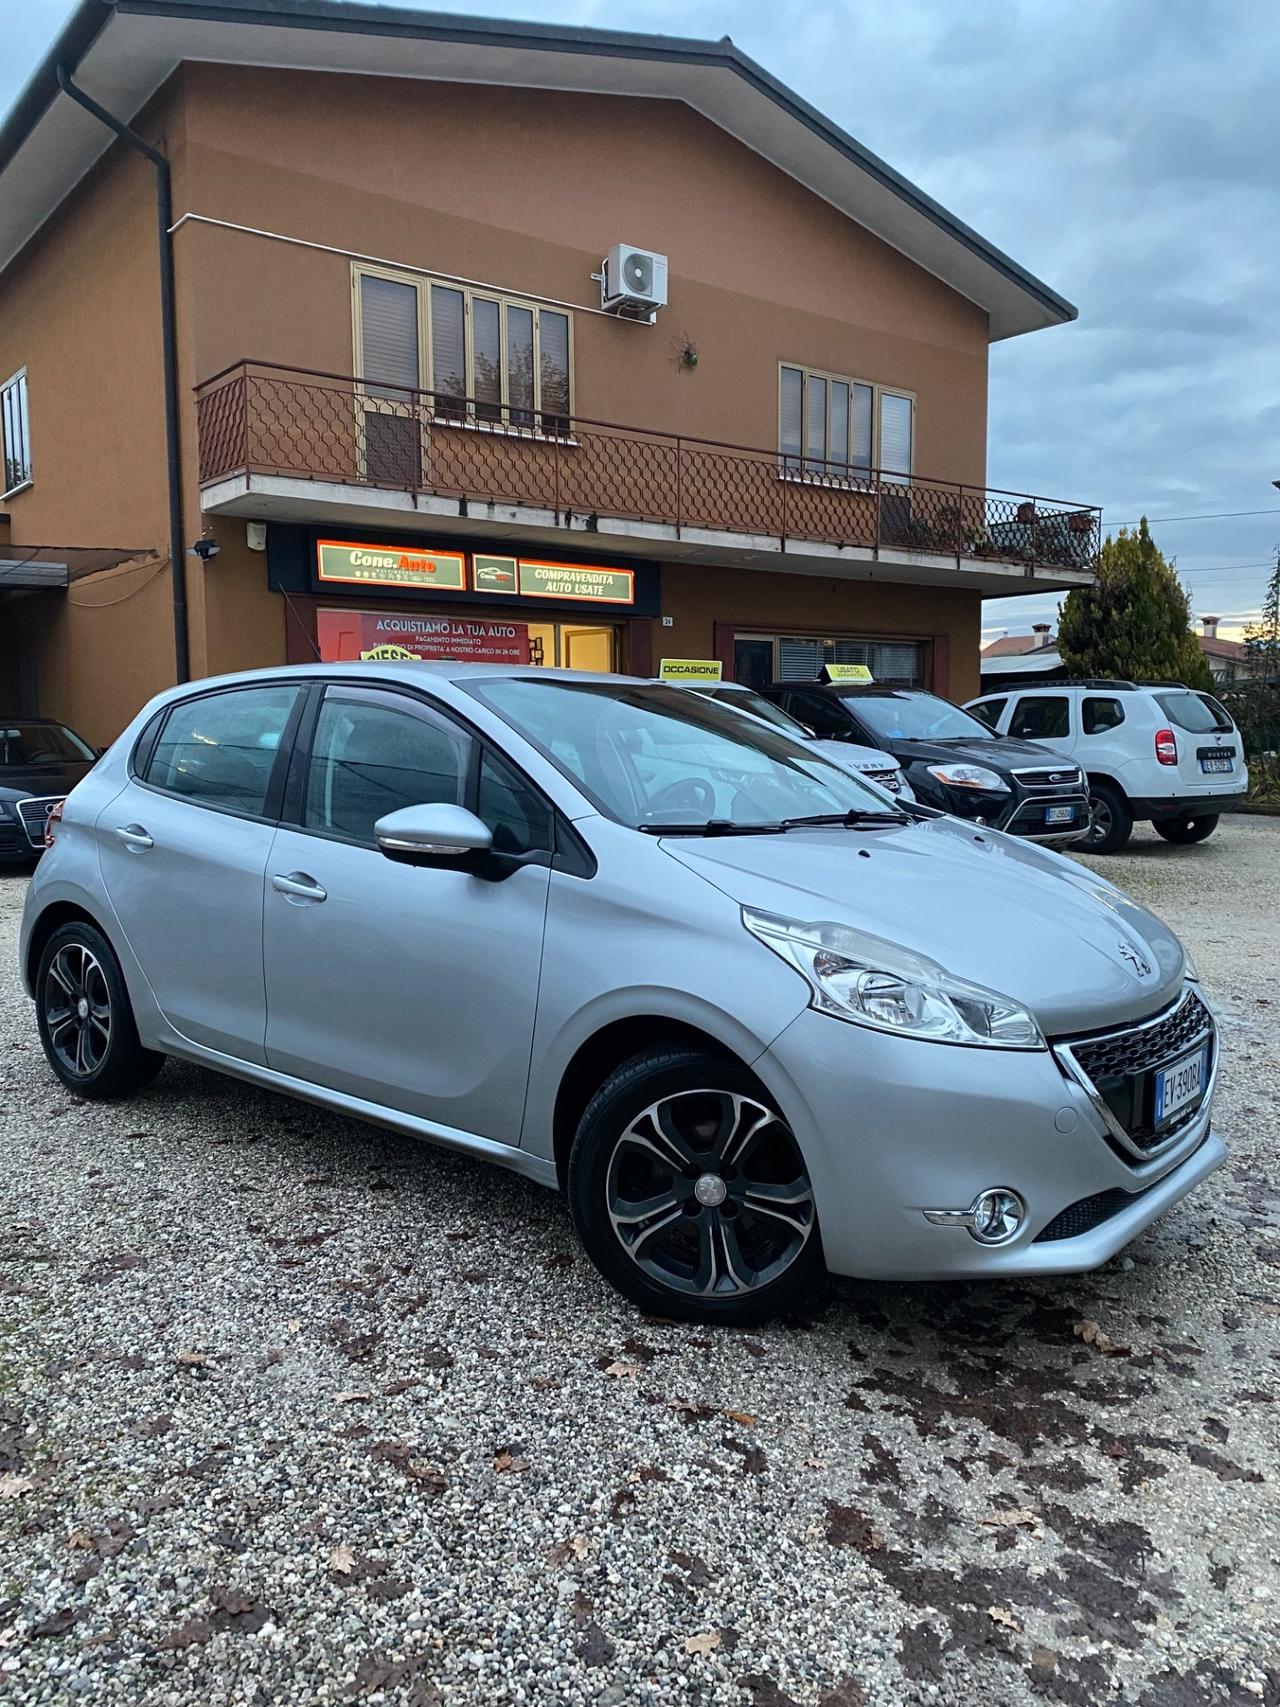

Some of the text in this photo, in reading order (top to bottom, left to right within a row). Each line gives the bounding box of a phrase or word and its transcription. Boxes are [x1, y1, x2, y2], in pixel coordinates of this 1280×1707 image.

[349, 550, 436, 573] Cone.Auto
[534, 568, 614, 585] COMPRAVENDITA
[545, 582, 604, 595] AUTO USATE
[376, 619, 516, 638] ACQUISTIAMO LA TUA AUTO
[415, 635, 482, 645] PAGAMENTO IMMEDIATO
[663, 665, 719, 675] OCCASIONE
[836, 666, 860, 674] USATO
